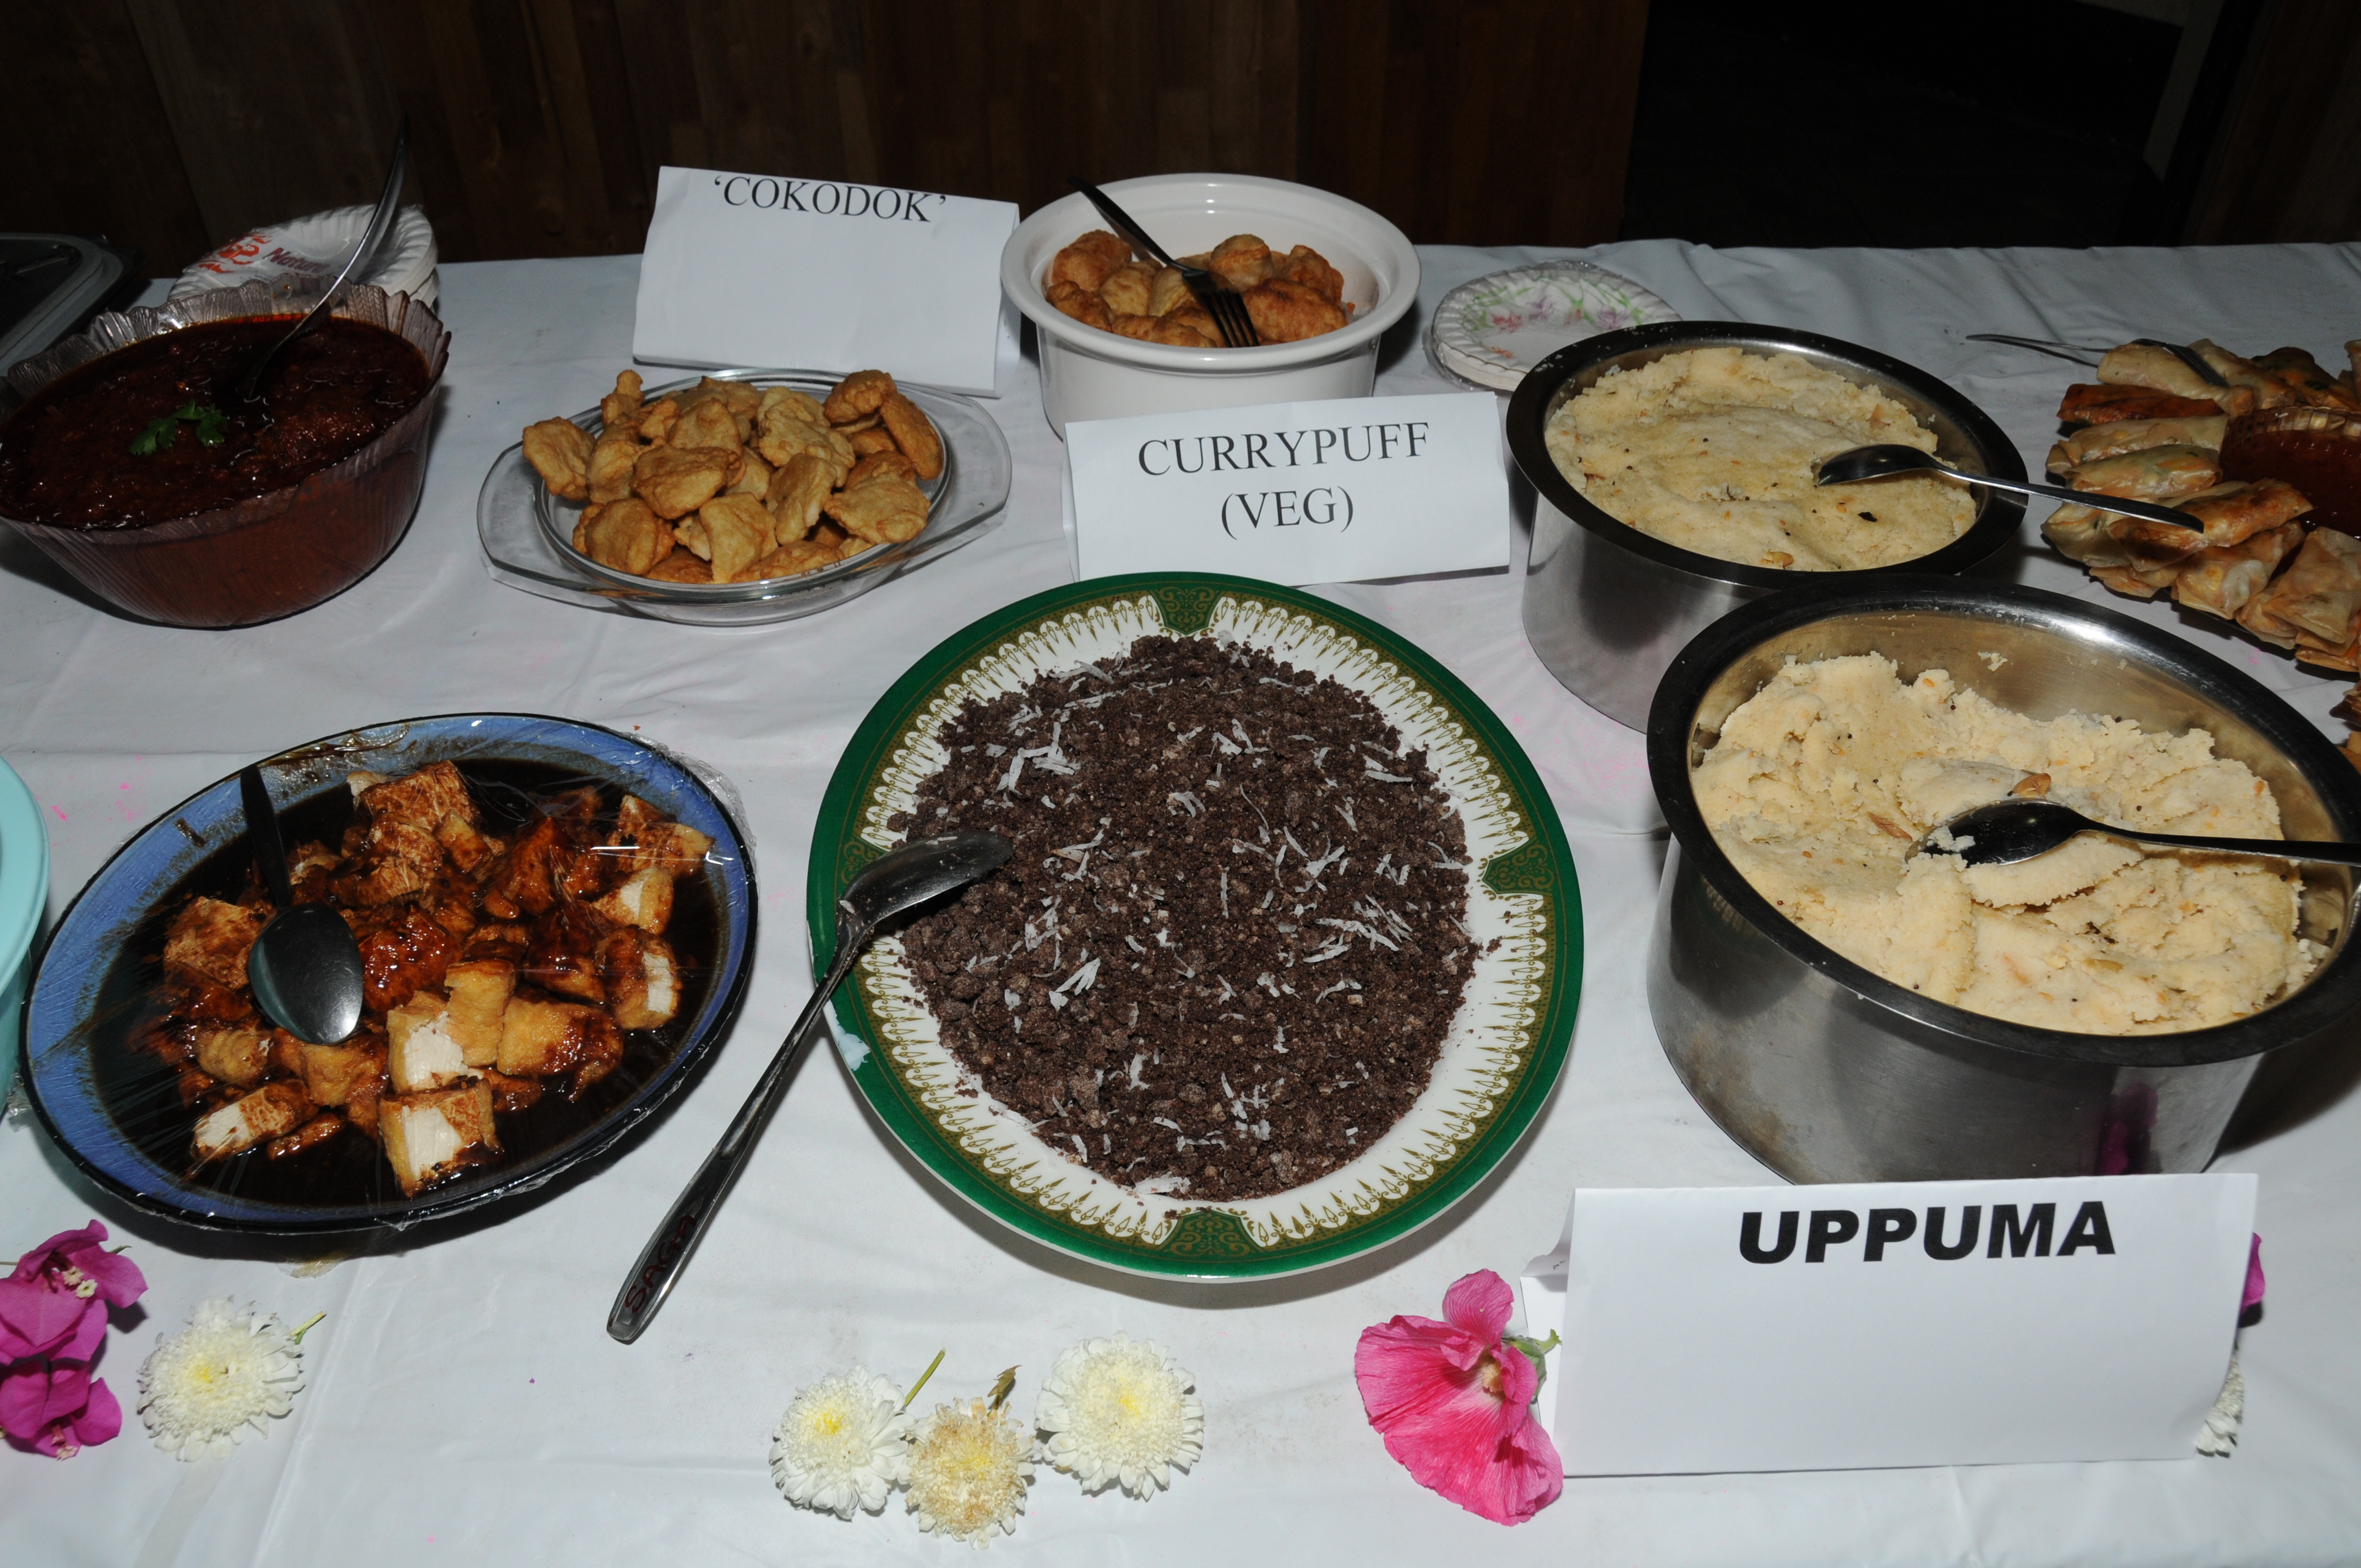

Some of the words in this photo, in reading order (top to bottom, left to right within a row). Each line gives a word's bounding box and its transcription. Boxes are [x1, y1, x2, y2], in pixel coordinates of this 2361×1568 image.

[1138, 422, 1430, 476] CURRYPUFF
[1221, 486, 1354, 540] (VEG)
[1739, 1201, 2116, 1265] UPPUMA
